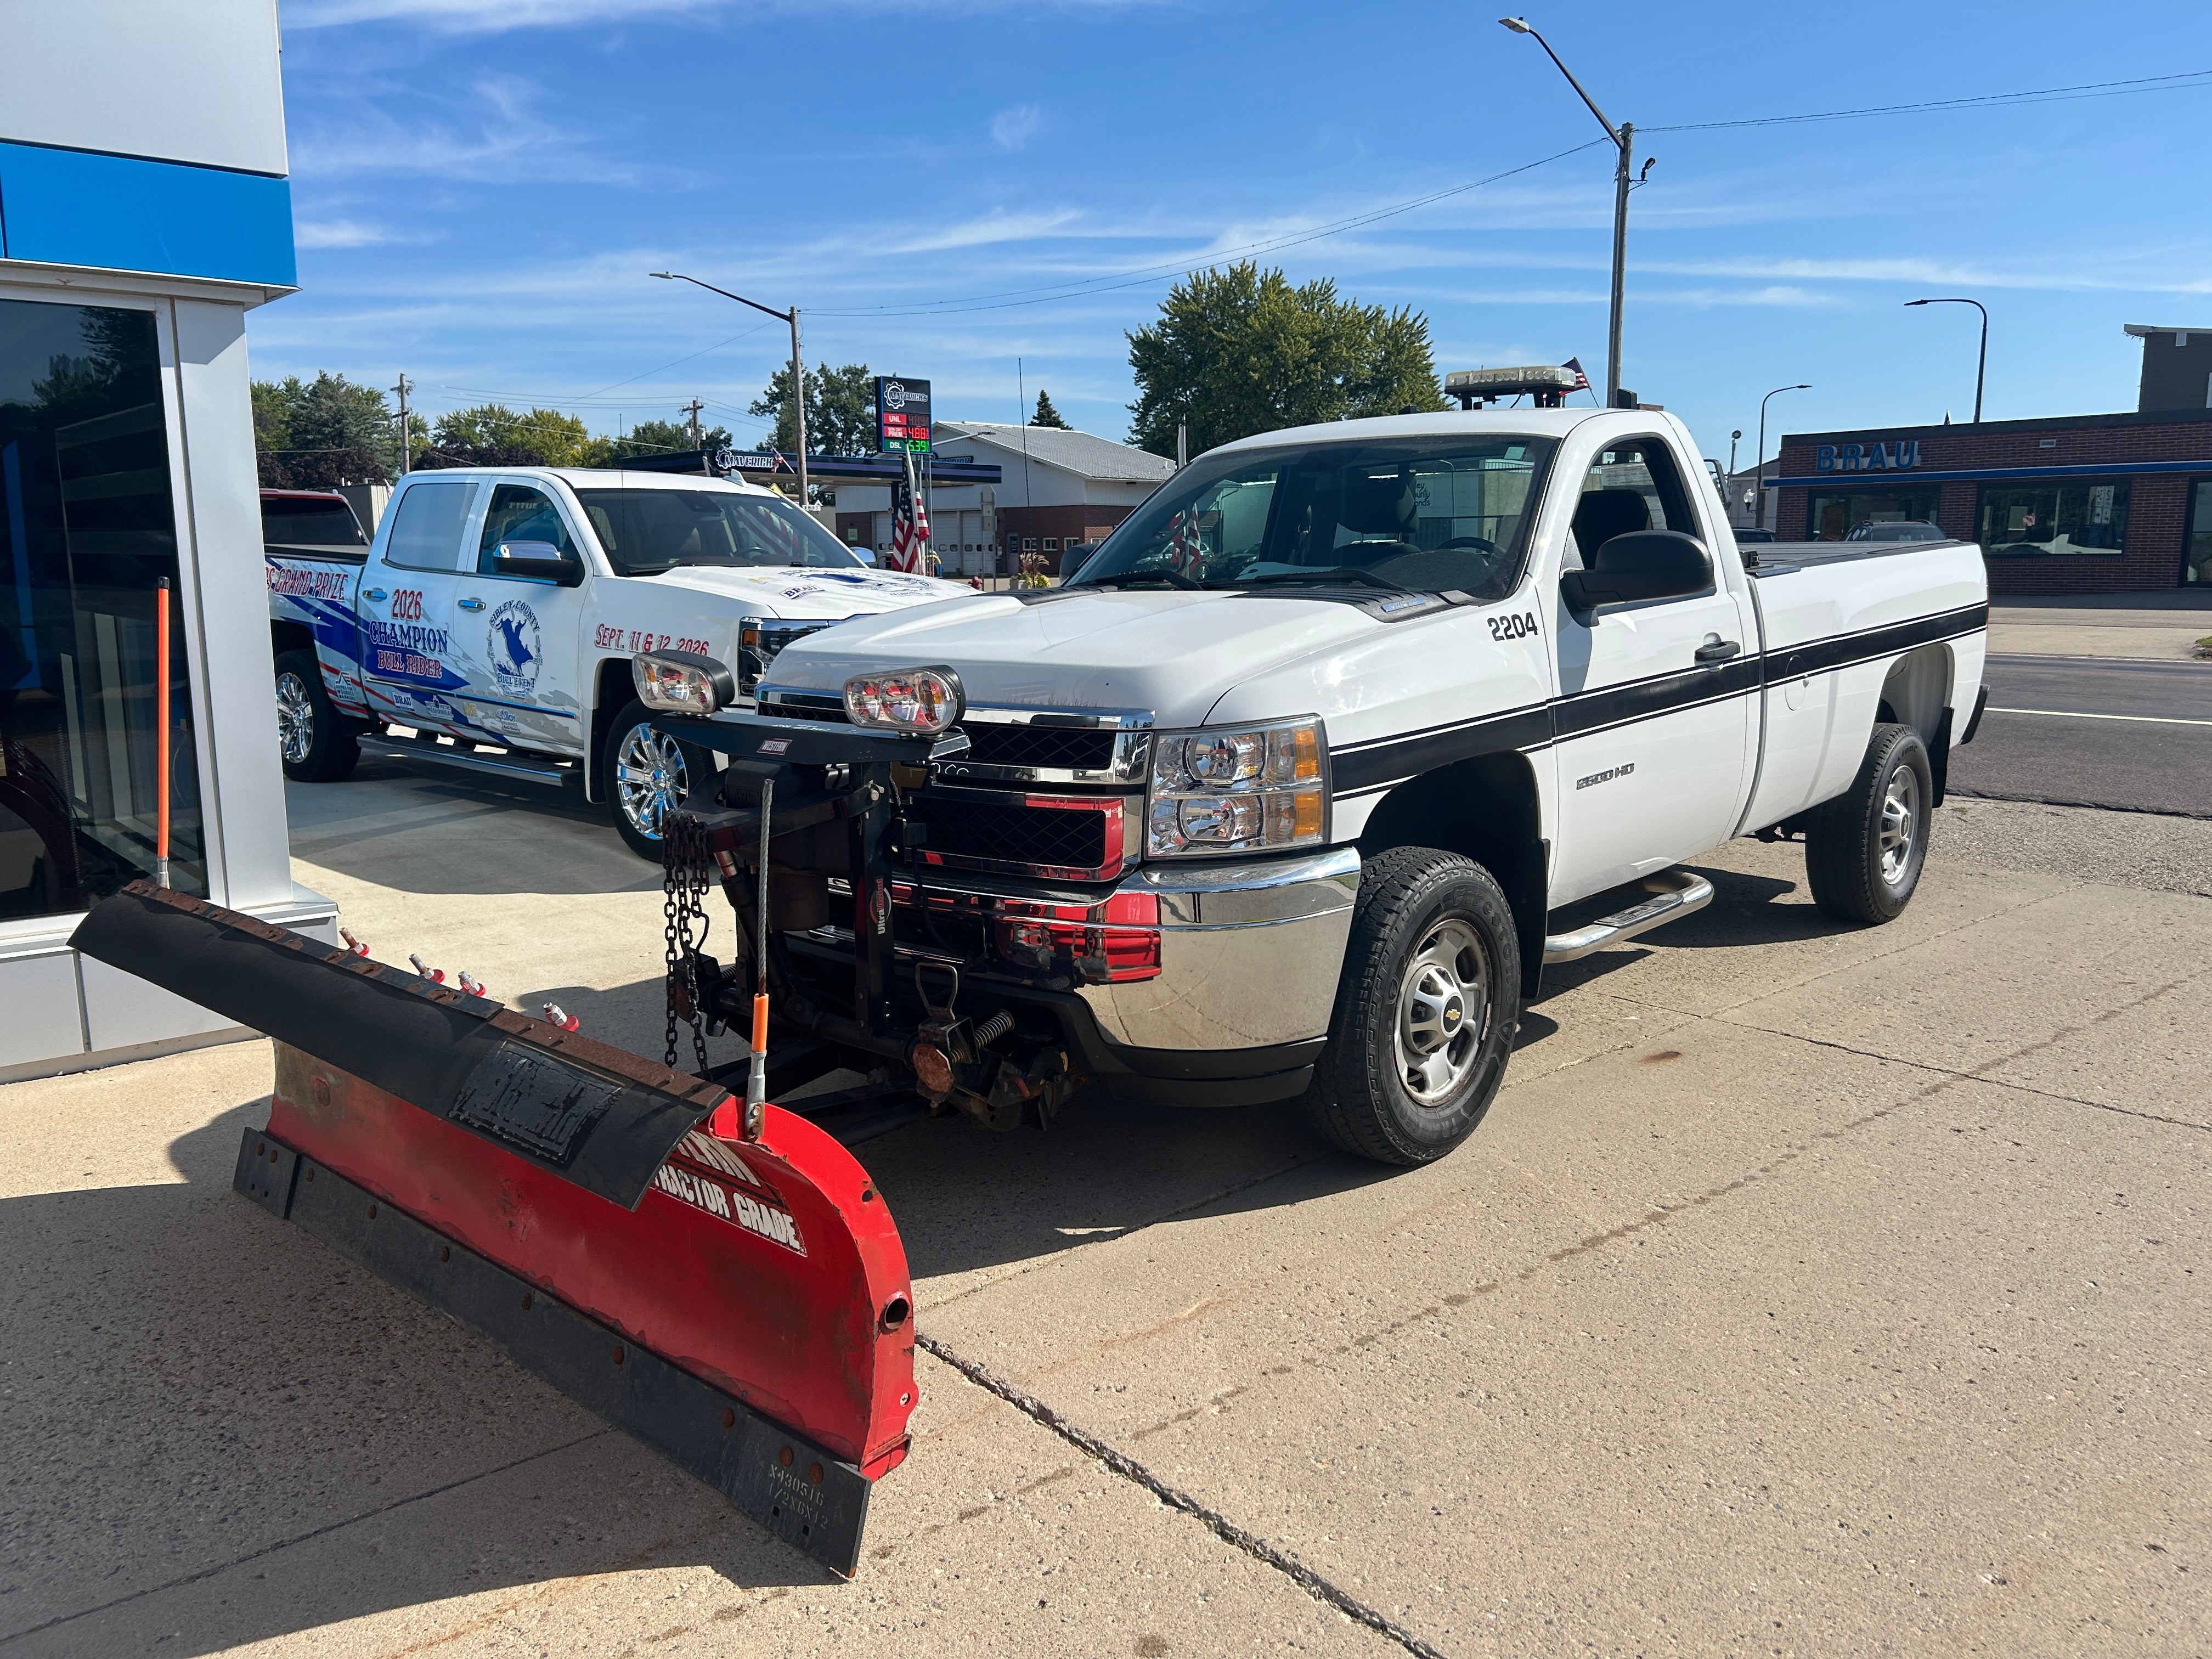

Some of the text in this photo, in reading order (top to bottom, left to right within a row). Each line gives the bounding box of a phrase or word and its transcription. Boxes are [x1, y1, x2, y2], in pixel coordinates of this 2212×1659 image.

[1816, 441, 1918, 472] BRAU
[275, 568, 312, 595] GRAND
[311, 572, 348, 600] PRIZE
[784, 585, 817, 597] BRAU
[392, 589, 423, 621] 2026
[490, 600, 540, 631] SIBLEY COUNTY
[370, 621, 448, 654] CHAMPION
[596, 623, 625, 648] SEPT.
[658, 634, 671, 650] 12
[678, 637, 709, 656] 2026
[1487, 612, 1538, 641] 2204
[377, 650, 442, 679] BULL RIDER
[497, 673, 536, 689] BULL EVENT
[393, 695, 411, 706] BRAU
[761, 740, 788, 752] WESTERN
[1615, 763, 1634, 779] HD
[1453, 887, 1515, 1006] Firestone
[733, 1192, 800, 1250] GRADE
